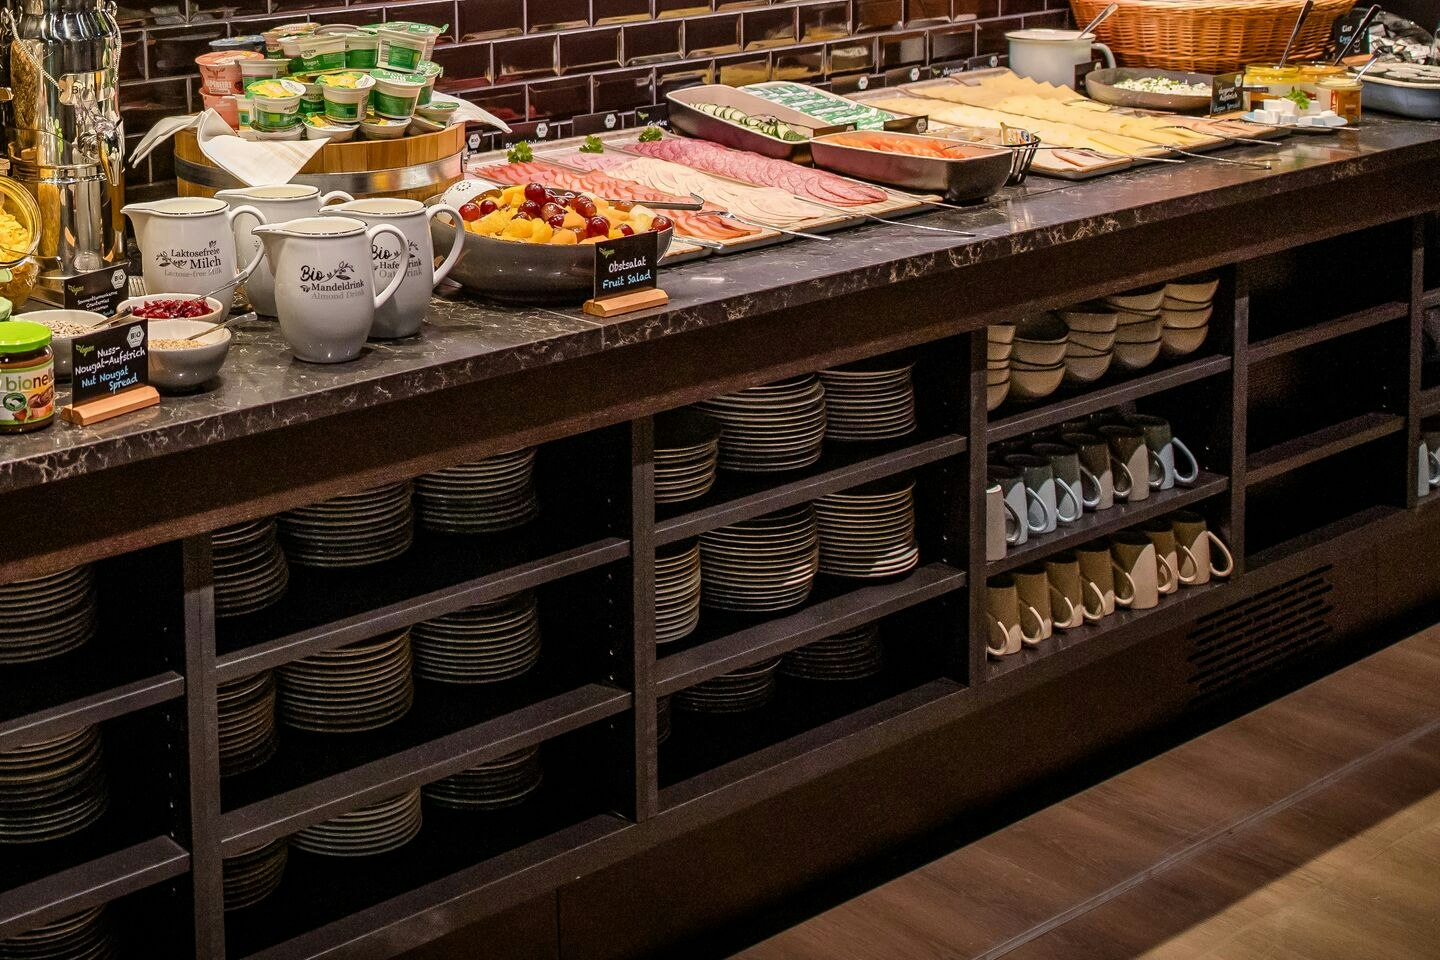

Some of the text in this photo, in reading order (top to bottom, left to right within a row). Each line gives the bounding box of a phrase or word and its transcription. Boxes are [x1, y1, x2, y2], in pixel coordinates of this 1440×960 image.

[171, 247, 220, 258] Laktosefreie
[189, 256, 222, 270] Milch
[608, 256, 647, 273] Obstsalat
[300, 265, 326, 282] Bio
[602, 269, 652, 289] Fruit Salad
[311, 279, 365, 292] Mandeldrink
[75, 346, 146, 375] Nougat-Aufstrich
[97, 346, 120, 358] Nuss-
[81, 365, 129, 388] Nut Nougat
[109, 372, 138, 394] Spread
